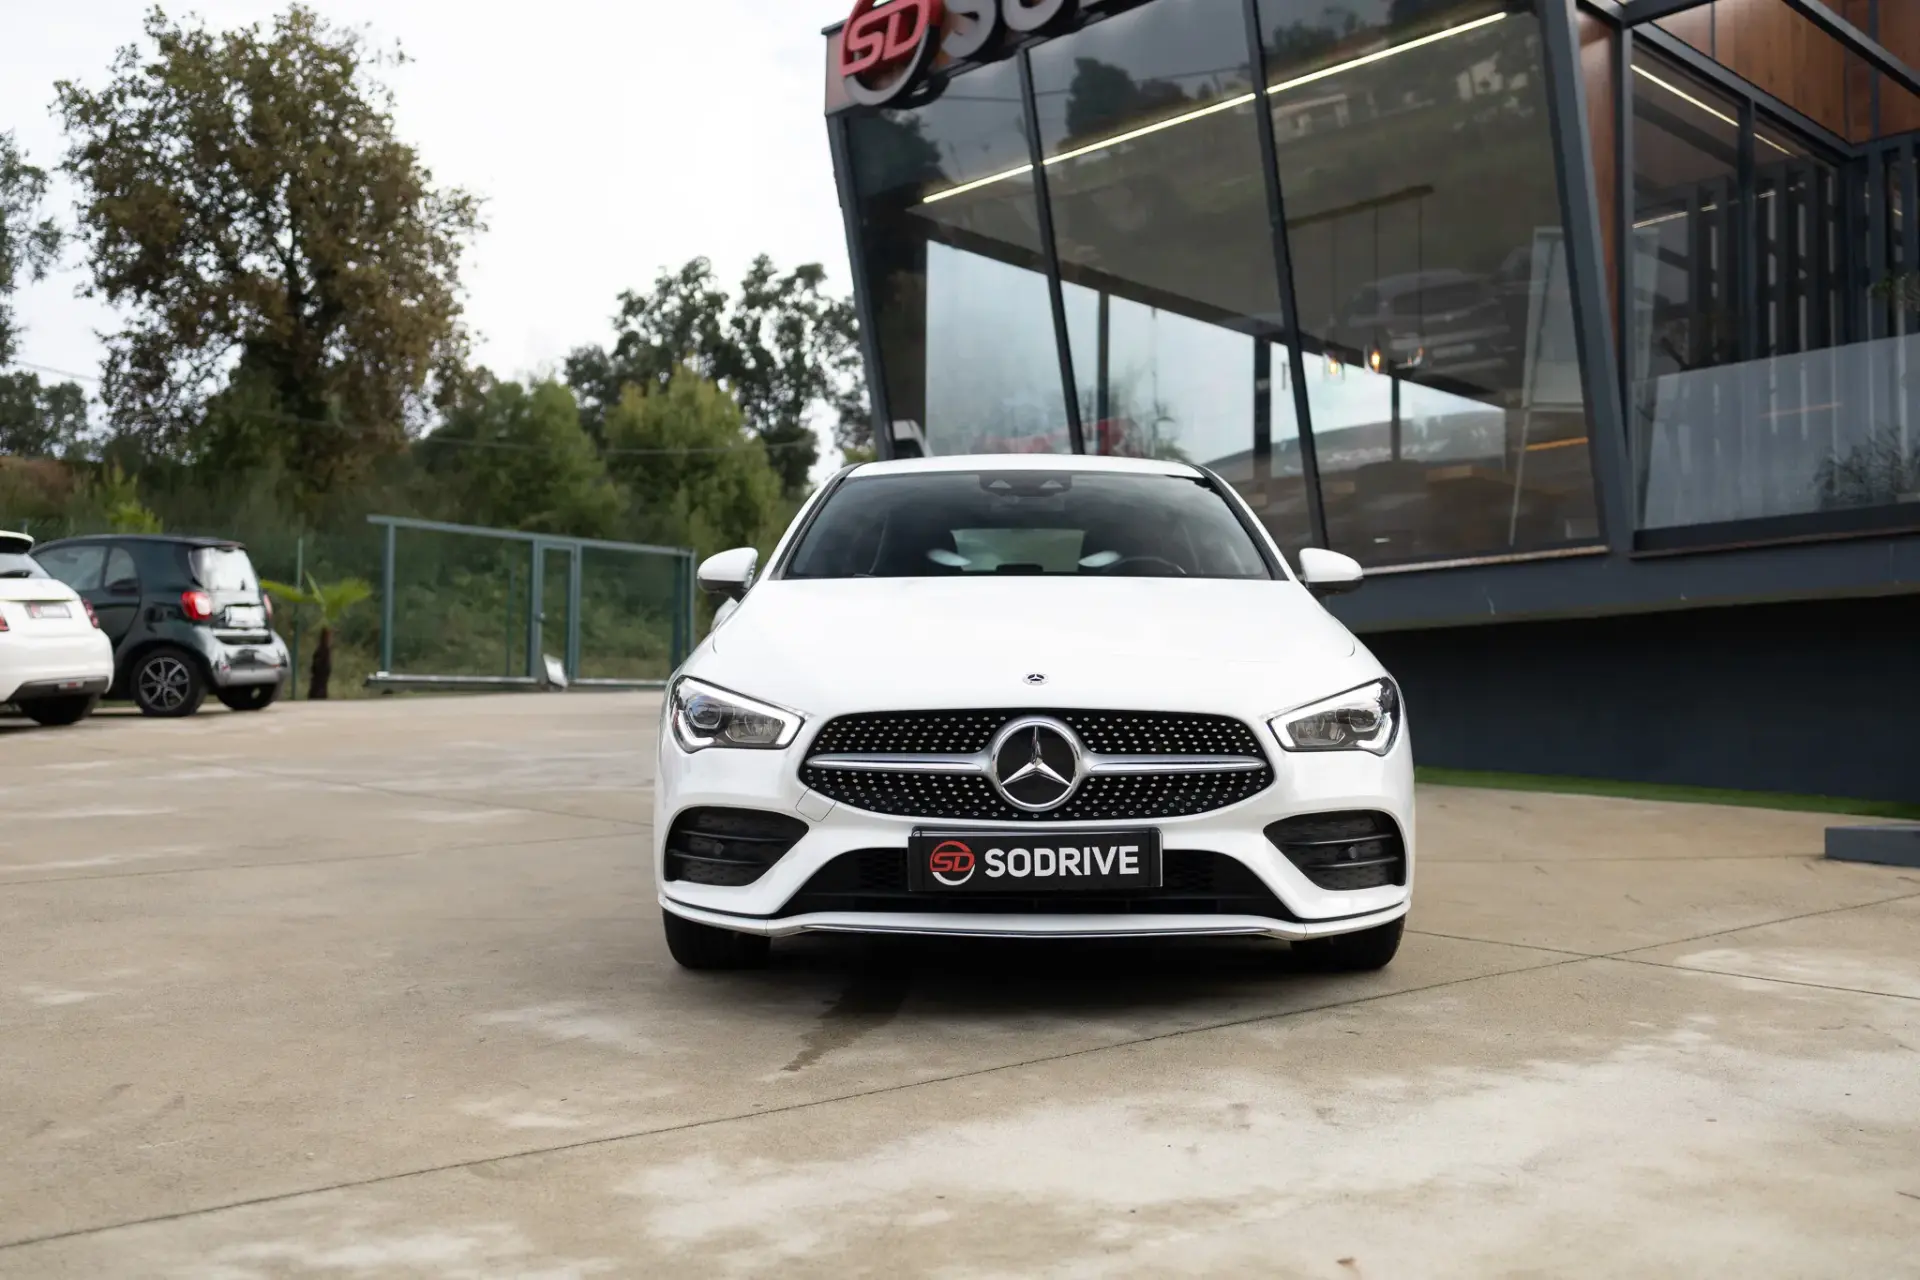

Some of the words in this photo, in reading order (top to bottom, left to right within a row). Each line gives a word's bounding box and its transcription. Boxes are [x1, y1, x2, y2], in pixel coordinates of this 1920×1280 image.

[839, 0, 930, 77] SD
[930, 852, 975, 872] SD
[984, 846, 1139, 878] SODRIVE
